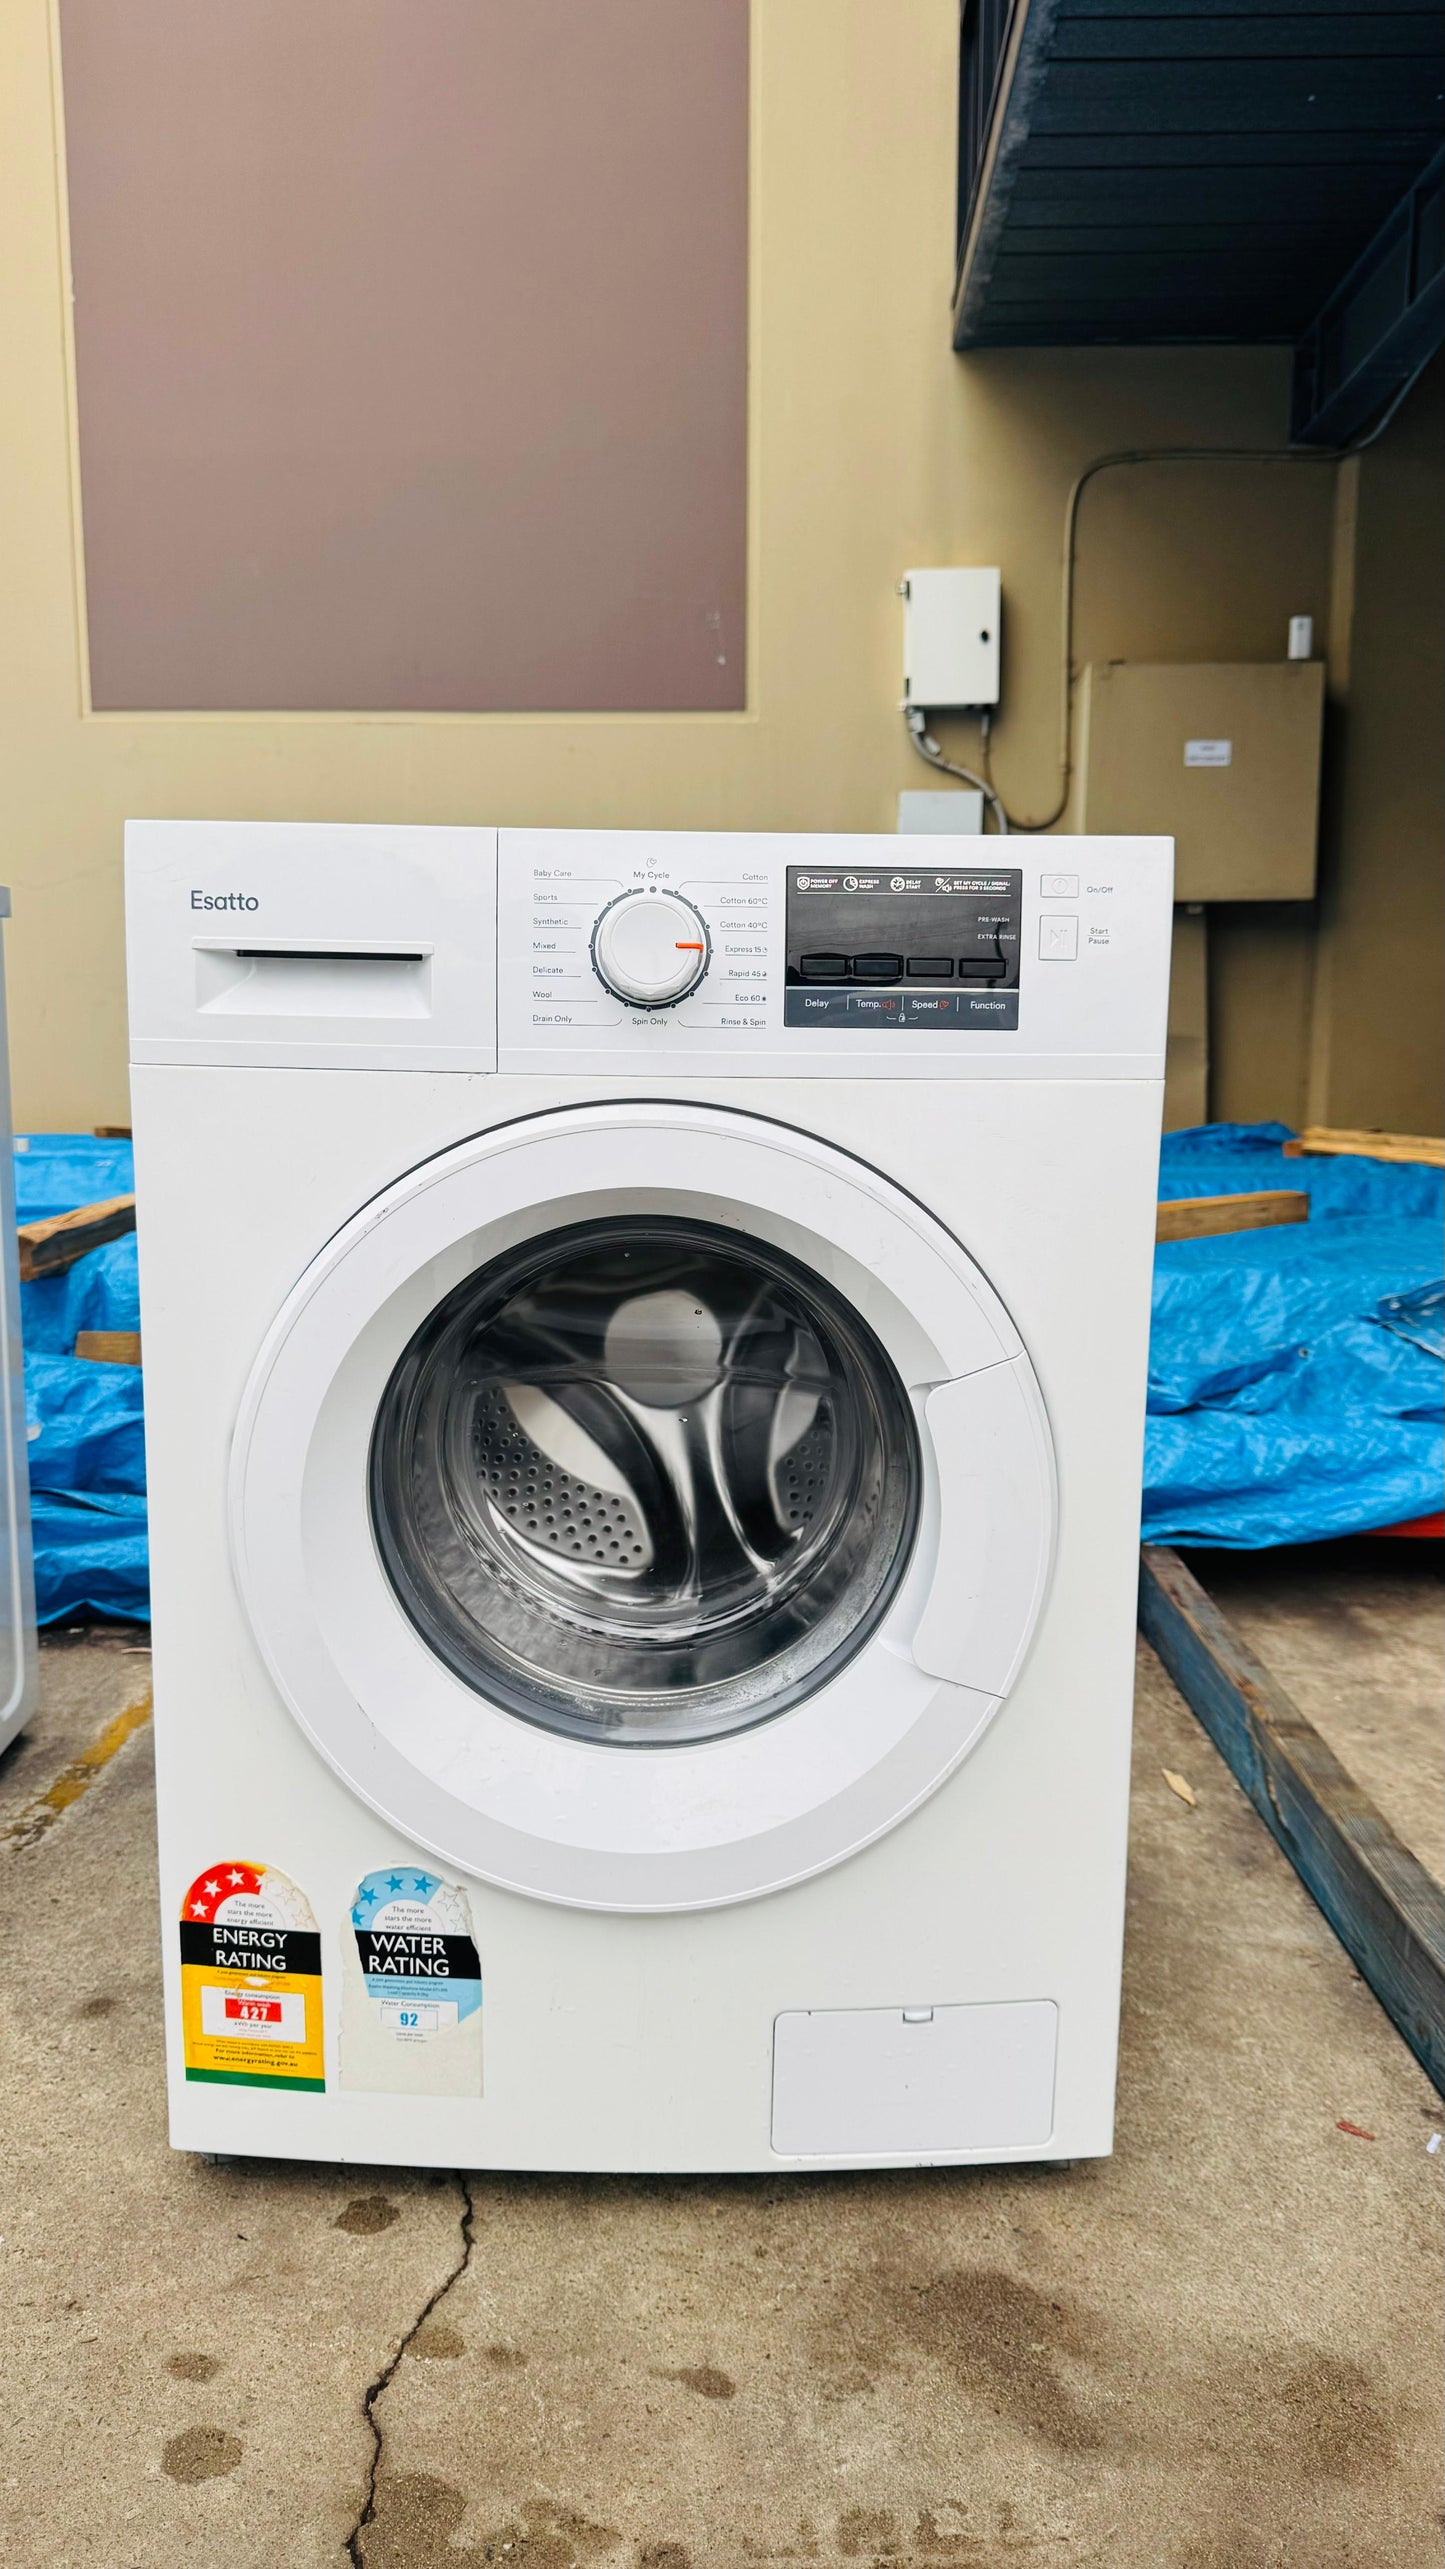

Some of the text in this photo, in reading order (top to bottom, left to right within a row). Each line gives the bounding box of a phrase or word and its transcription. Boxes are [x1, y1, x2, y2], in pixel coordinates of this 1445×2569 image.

[633, 872, 670, 880] My Cycle
[190, 890, 259, 911] Esatto
[534, 893, 558, 901] Sports
[805, 999, 829, 1009] Delay
[856, 1000, 881, 1009] Temp.
[912, 1000, 938, 1010] Speed
[970, 1001, 1005, 1010] Function
[632, 1018, 668, 1027] Spin Only
[750, 1018, 766, 1026] Spin
[213, 1928, 287, 1948] ENERGY
[371, 1934, 446, 1955] WATER
[216, 1950, 286, 1970] RATING
[369, 1955, 449, 1976] RATING
[240, 2006, 268, 2020] 427
[400, 2012, 418, 2026] 92
